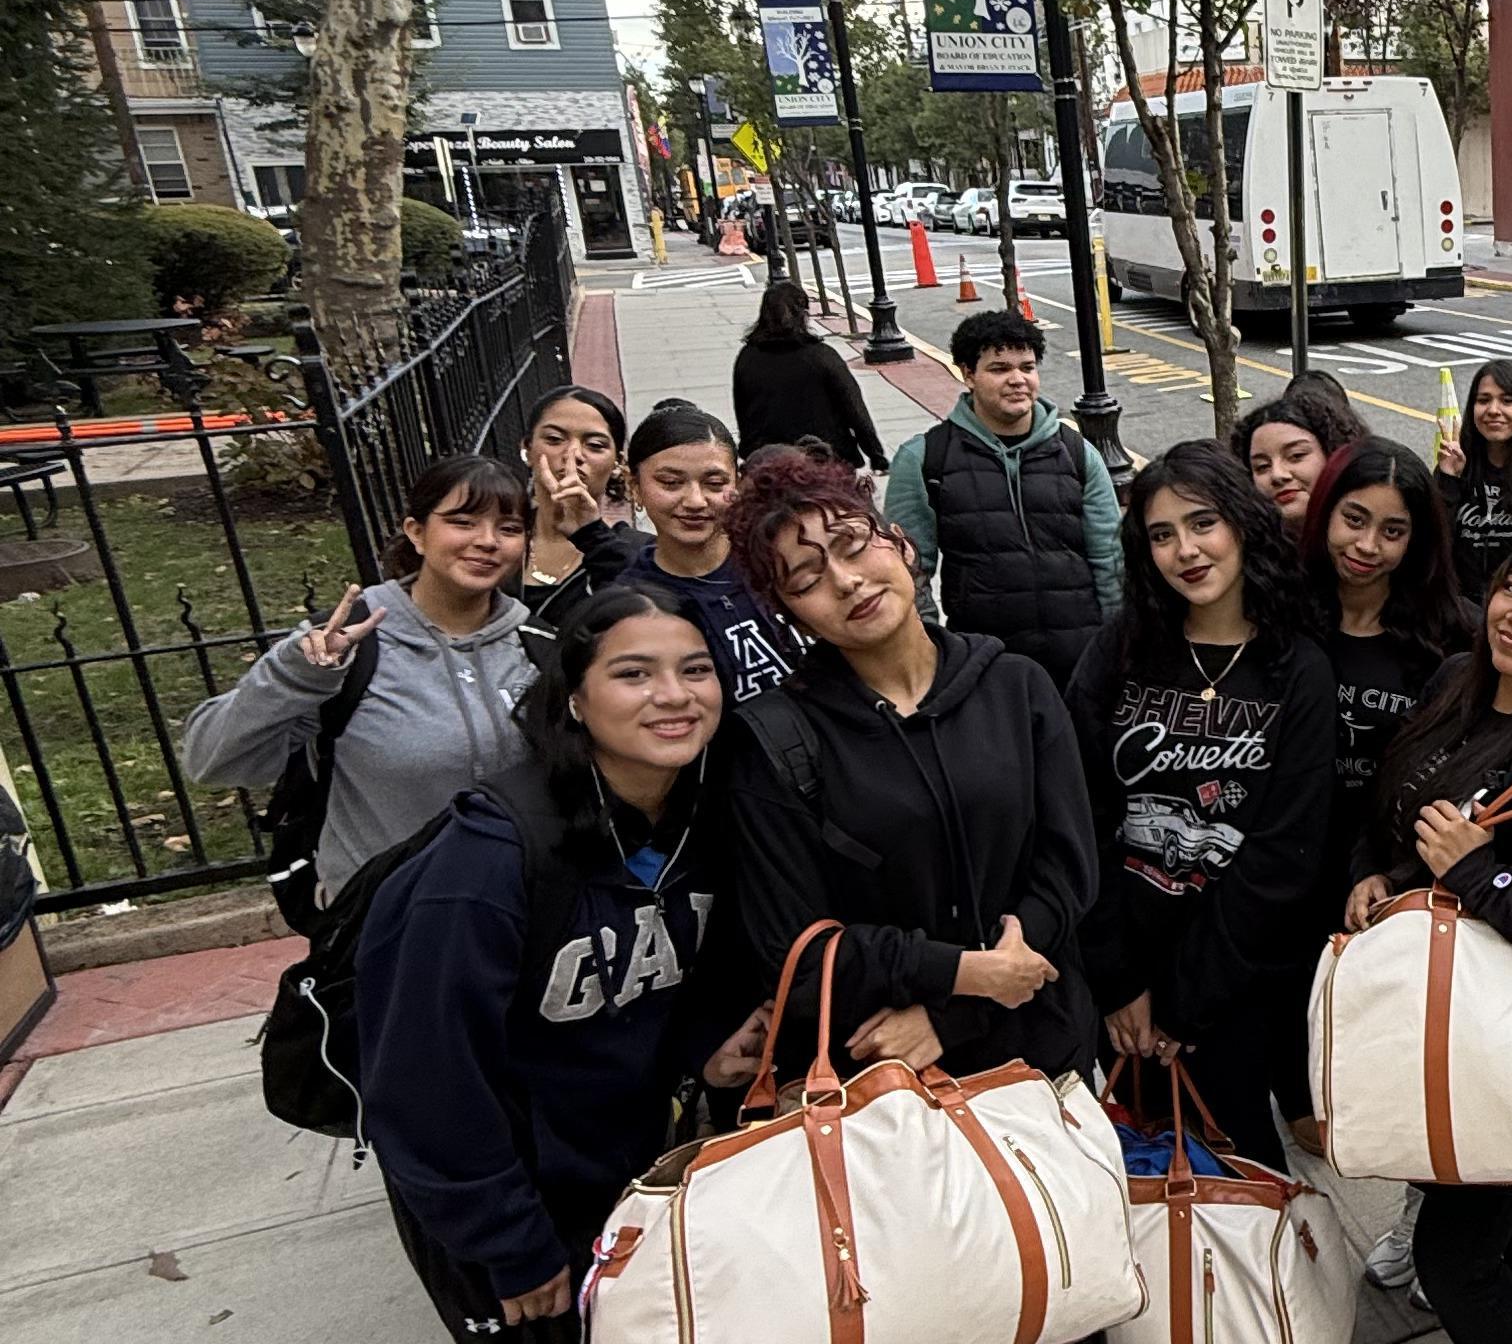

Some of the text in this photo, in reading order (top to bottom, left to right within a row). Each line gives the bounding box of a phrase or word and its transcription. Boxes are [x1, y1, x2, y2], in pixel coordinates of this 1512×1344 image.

[936, 34, 1028, 49] UNION CITY
[1270, 27, 1318, 41] NO PARKING
[477, 136, 532, 153] Beauty
[533, 135, 576, 150] Salon
[1111, 680, 1282, 740] CHEVY
[1361, 688, 1419, 714] CITY
[1112, 721, 1272, 787] Corvette
